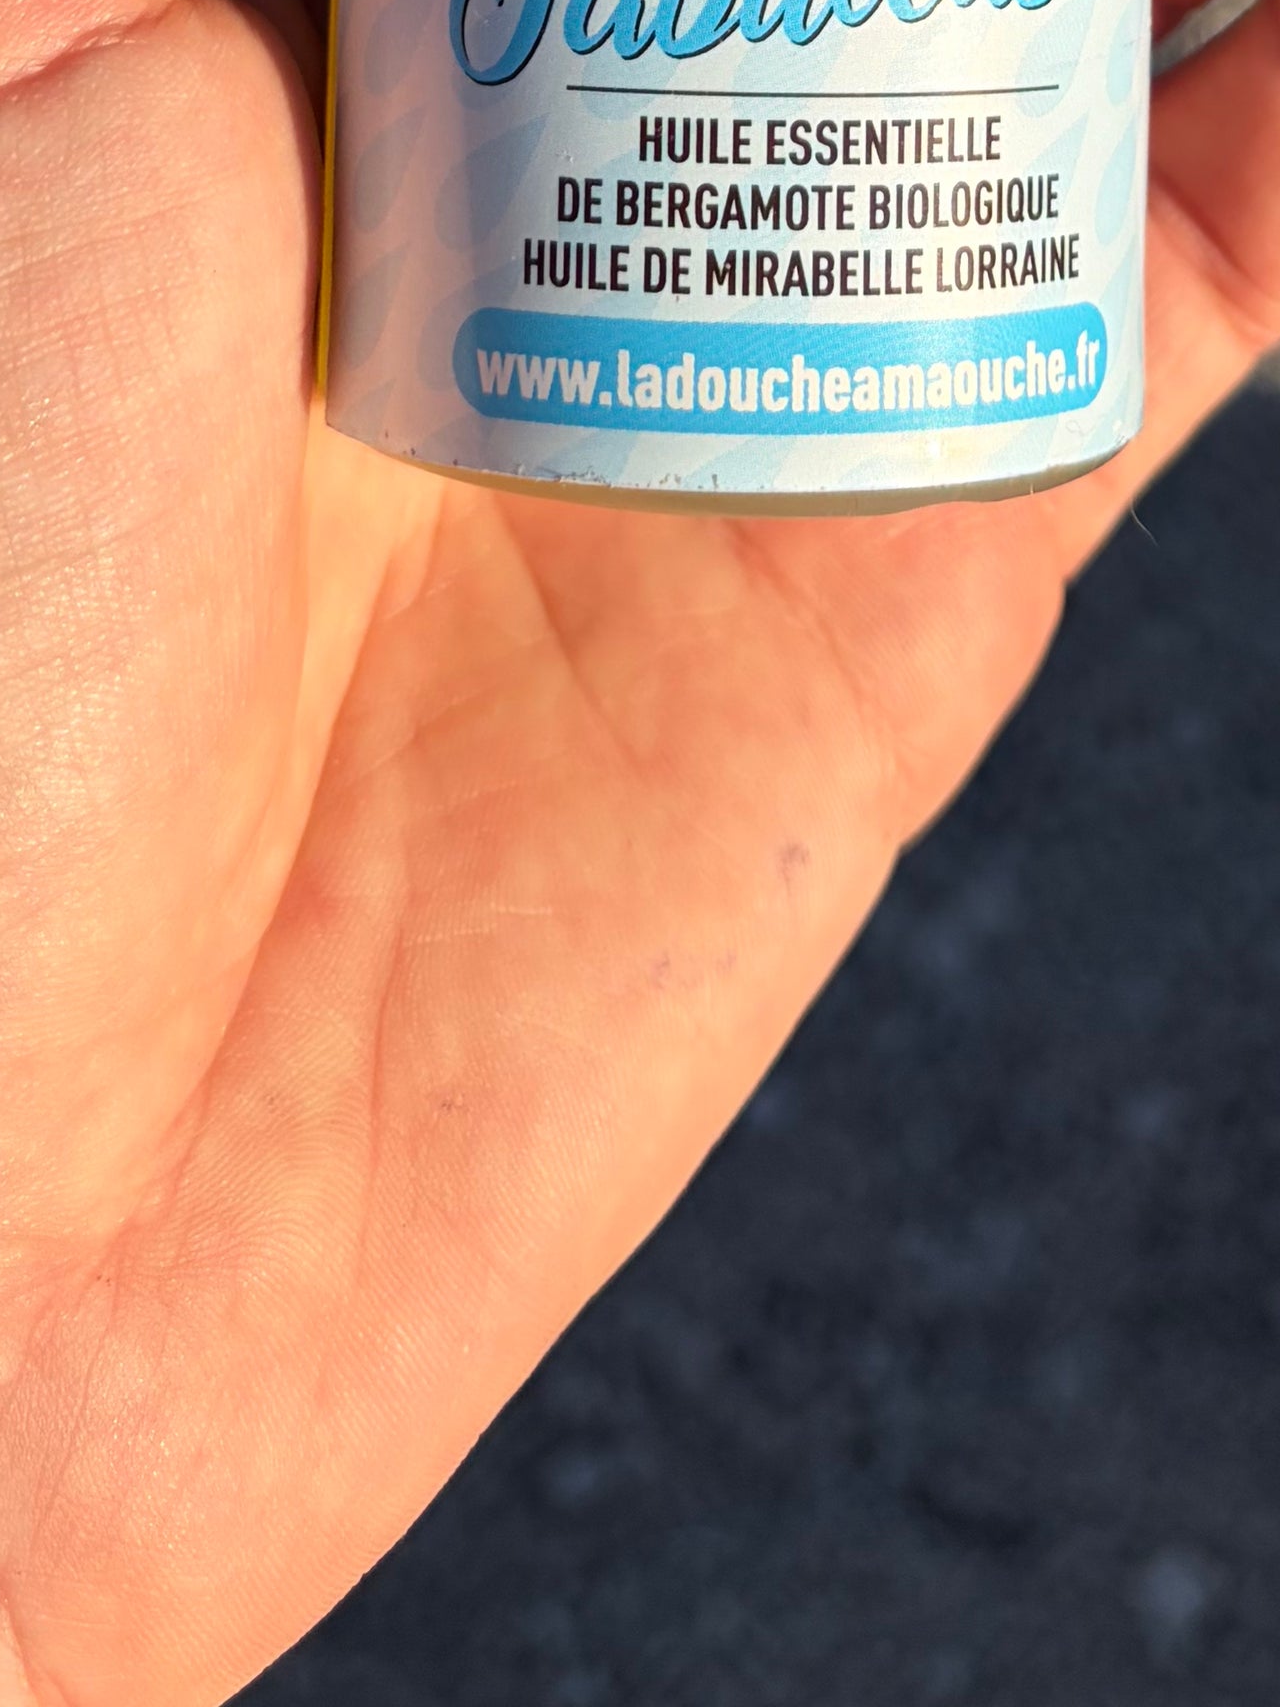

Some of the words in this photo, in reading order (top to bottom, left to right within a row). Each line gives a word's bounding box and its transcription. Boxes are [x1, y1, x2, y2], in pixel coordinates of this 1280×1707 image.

[638, 116, 753, 165] HUILE
[765, 115, 1002, 166] ESSENTIELLE
[556, 177, 603, 225] DE
[616, 182, 855, 231] BERGAMOTE
[868, 173, 1060, 230] BIOLOGIQUE
[523, 237, 629, 292] HUILE
[643, 251, 691, 295] DE
[704, 248, 922, 297] MIRABELLE
[935, 234, 1081, 293] LORRAINE
[476, 331, 1100, 413] www.ladoucheamaouche.fr
